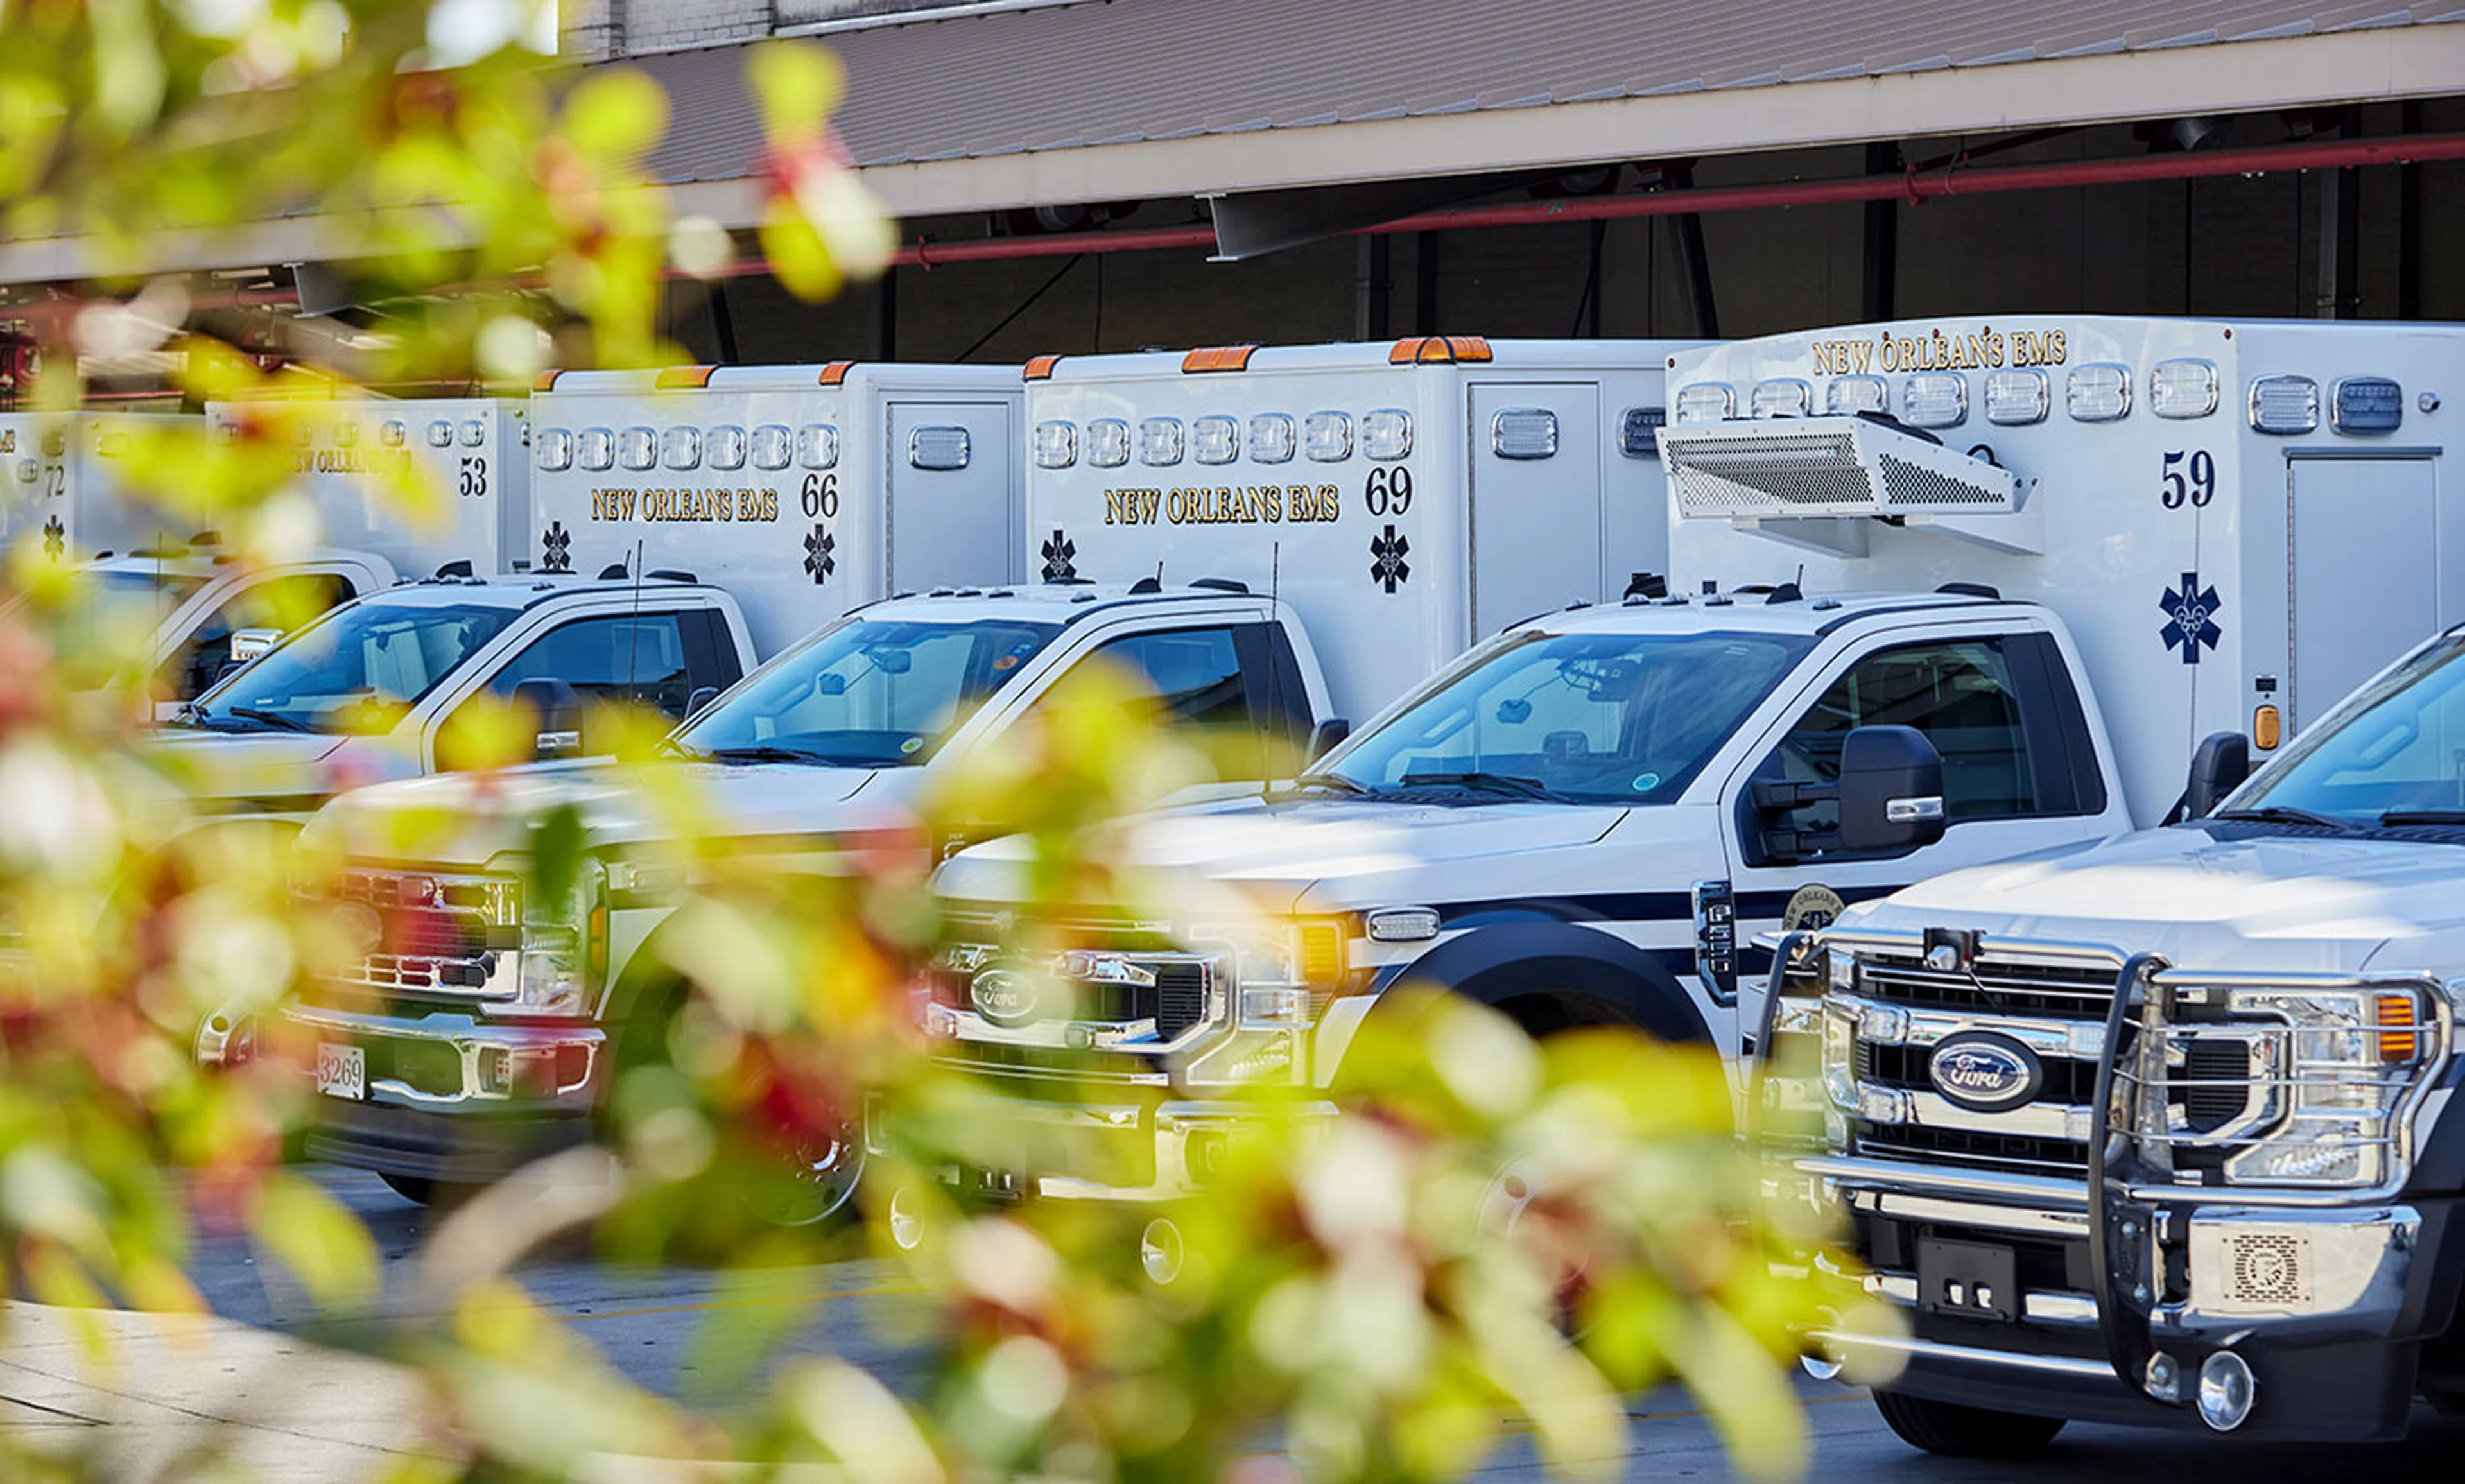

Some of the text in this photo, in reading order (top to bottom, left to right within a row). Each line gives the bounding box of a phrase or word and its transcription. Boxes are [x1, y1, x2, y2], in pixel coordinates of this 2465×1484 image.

[1812, 329, 2066, 375] NEW ORLEANS EMS
[45, 465, 65, 498] 72
[460, 456, 487, 496] 53
[801, 473, 838, 518] 66
[1365, 466, 1412, 516] 69
[2162, 449, 2215, 510] 59
[591, 488, 778, 522] NEW ORLEANS EMS
[1104, 485, 1340, 525] NEW ORLEANS EMS
[320, 1055, 361, 1088] 3269
[1950, 1053, 2003, 1089] Ford
